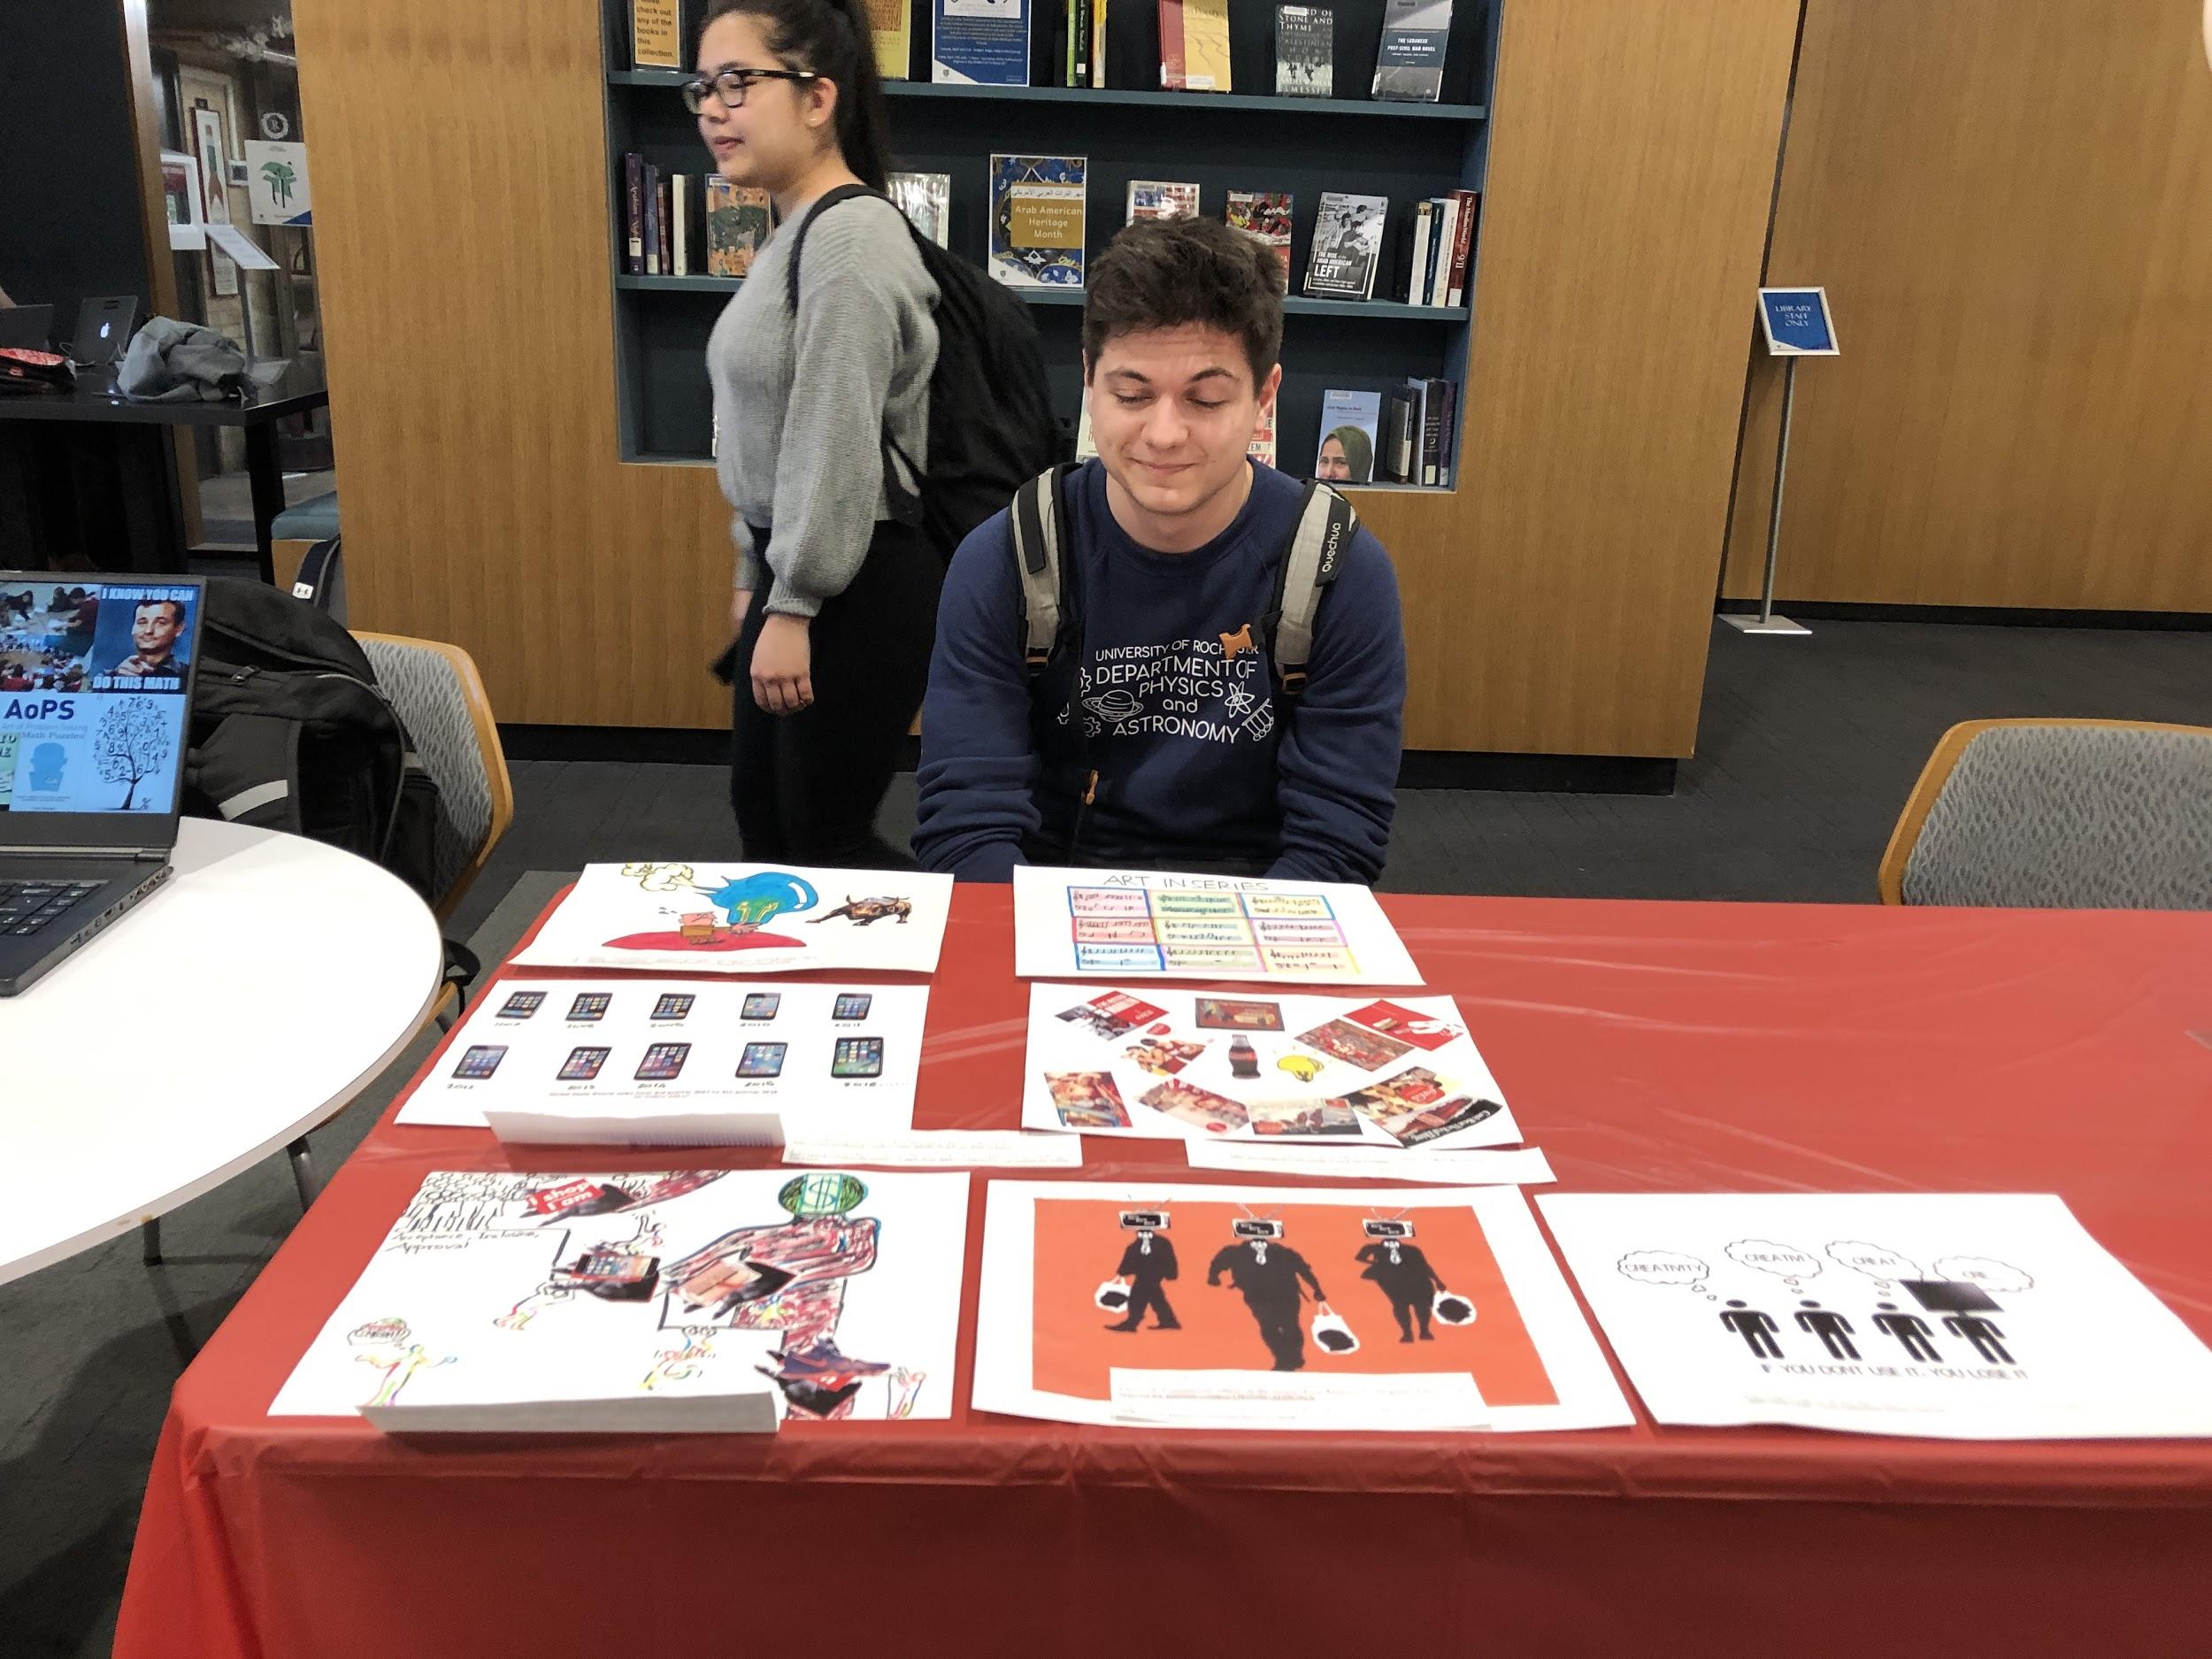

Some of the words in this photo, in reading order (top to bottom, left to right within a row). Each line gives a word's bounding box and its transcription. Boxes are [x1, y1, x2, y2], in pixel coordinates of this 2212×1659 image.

[1279, 14, 1309, 23] STONE
[1279, 22, 1311, 31] THYME
[637, 27, 659, 35] books
[1015, 205, 1037, 214] Arab
[1039, 206, 1082, 216] American
[1029, 219, 1068, 227] Heritage
[1033, 229, 1063, 239] Month
[1314, 265, 1340, 278] LEFT
[1322, 522, 1341, 572] Quechua
[102, 588, 108, 599] I
[109, 588, 144, 600] KNOW
[146, 588, 169, 601] YOU
[170, 589, 194, 602] CAN
[1095, 644, 1169, 662] UNIVERSITY
[1171, 639, 1190, 651] OF
[1096, 656, 1233, 685] DEPARTMENT
[1236, 659, 1258, 680] OF
[92, 675, 111, 689] DO
[112, 676, 142, 689] THIS
[143, 677, 180, 690] MATH
[1139, 676, 1225, 698] PHYSICS
[4, 698, 74, 720] AoPS
[1162, 696, 1198, 713] and
[1112, 715, 1240, 743] ASTRONOMY
[1103, 874, 1149, 887] ART
[1164, 877, 1186, 888] IN
[1191, 879, 1269, 892] SERIES
[542, 1182, 590, 1202] shop
[547, 1202, 557, 1211] I
[561, 1192, 593, 1206] am
[385, 1239, 471, 1255] Approval
[1624, 1263, 1702, 1273] CREATIVITY
[1779, 1364, 1816, 1375] YOU
[1868, 1366, 1901, 1378] USE
[1928, 1368, 1965, 1379] YOU
[1968, 1369, 2010, 1380] LOSE
[2013, 1370, 2029, 1380] IT
